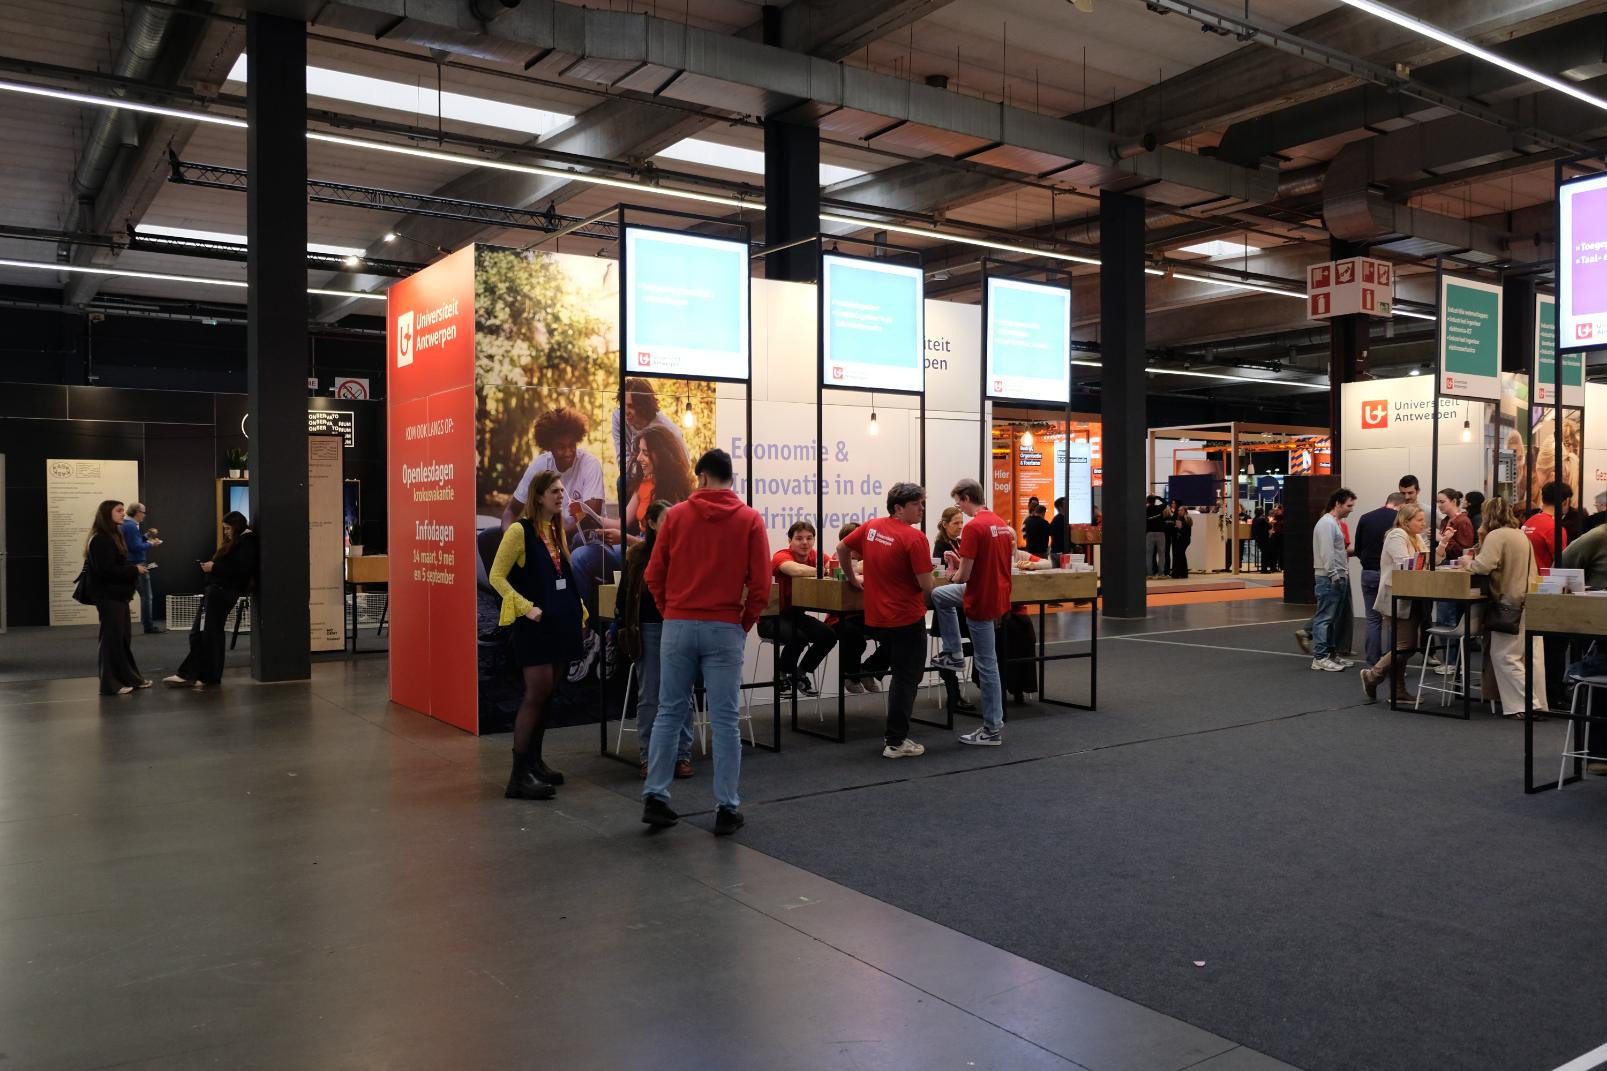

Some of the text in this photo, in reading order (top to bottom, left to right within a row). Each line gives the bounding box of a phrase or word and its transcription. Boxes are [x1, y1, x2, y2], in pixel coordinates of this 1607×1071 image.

[416, 297, 459, 330] Universiteit
[416, 325, 457, 352] Antwerpen
[1394, 399, 1460, 411] Universteit
[835, 440, 849, 462] &
[402, 459, 454, 488] Openlesdagen
[835, 473, 854, 496] in
[860, 474, 883, 496] de
[994, 470, 1009, 478] Hier
[762, 507, 878, 532] drijfswereld
[415, 520, 454, 546] Infodagen
